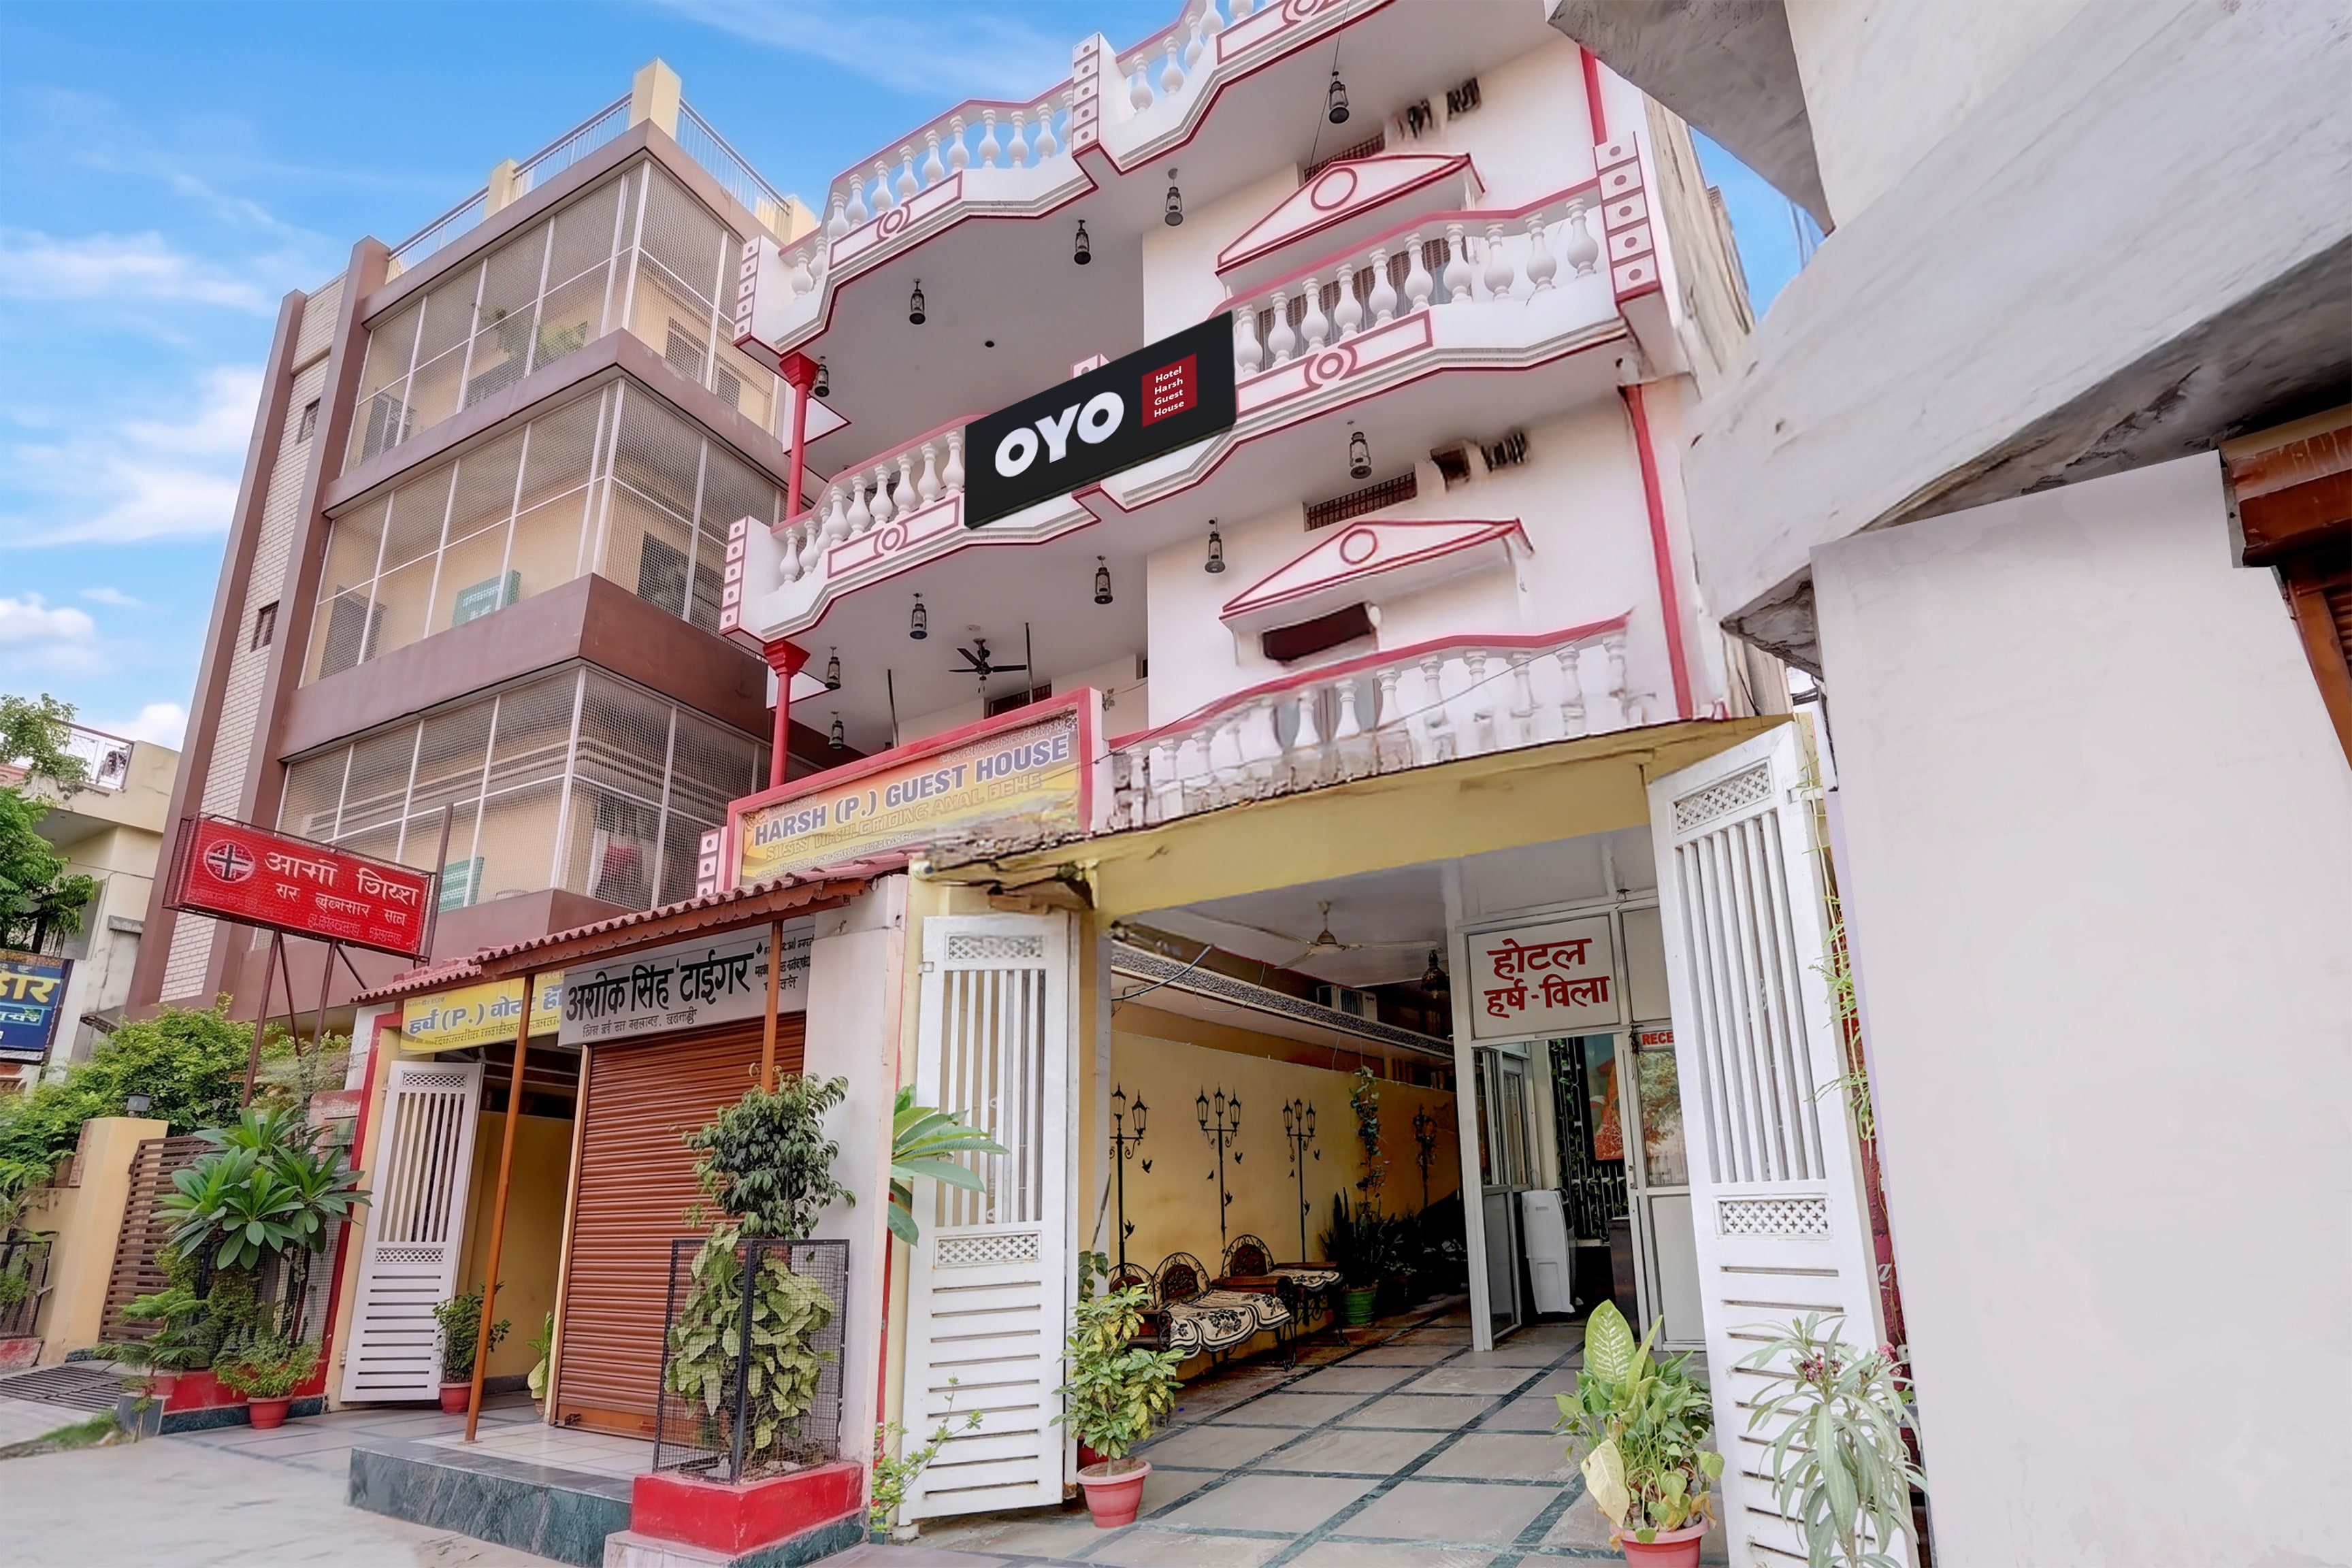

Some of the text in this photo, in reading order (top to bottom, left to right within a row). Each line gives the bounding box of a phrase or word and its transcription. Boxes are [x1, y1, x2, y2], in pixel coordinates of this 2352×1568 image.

[1156, 365, 1182, 383] Hotel
[1154, 378, 1183, 395] Harsh
[1154, 389, 1183, 406] Guest
[1154, 401, 1184, 417] House
[995, 391, 1124, 477] OYO
[754, 805, 827, 846] HARSH
[834, 789, 877, 823] (P.)
[885, 764, 967, 808] GUEST
[976, 733, 1070, 783] HOUSE
[1486, 938, 1592, 981] होटल
[566, 970, 630, 1021] अशोक
[632, 964, 674, 1011] सिंह
[1642, 1031, 1673, 1045] RECE
